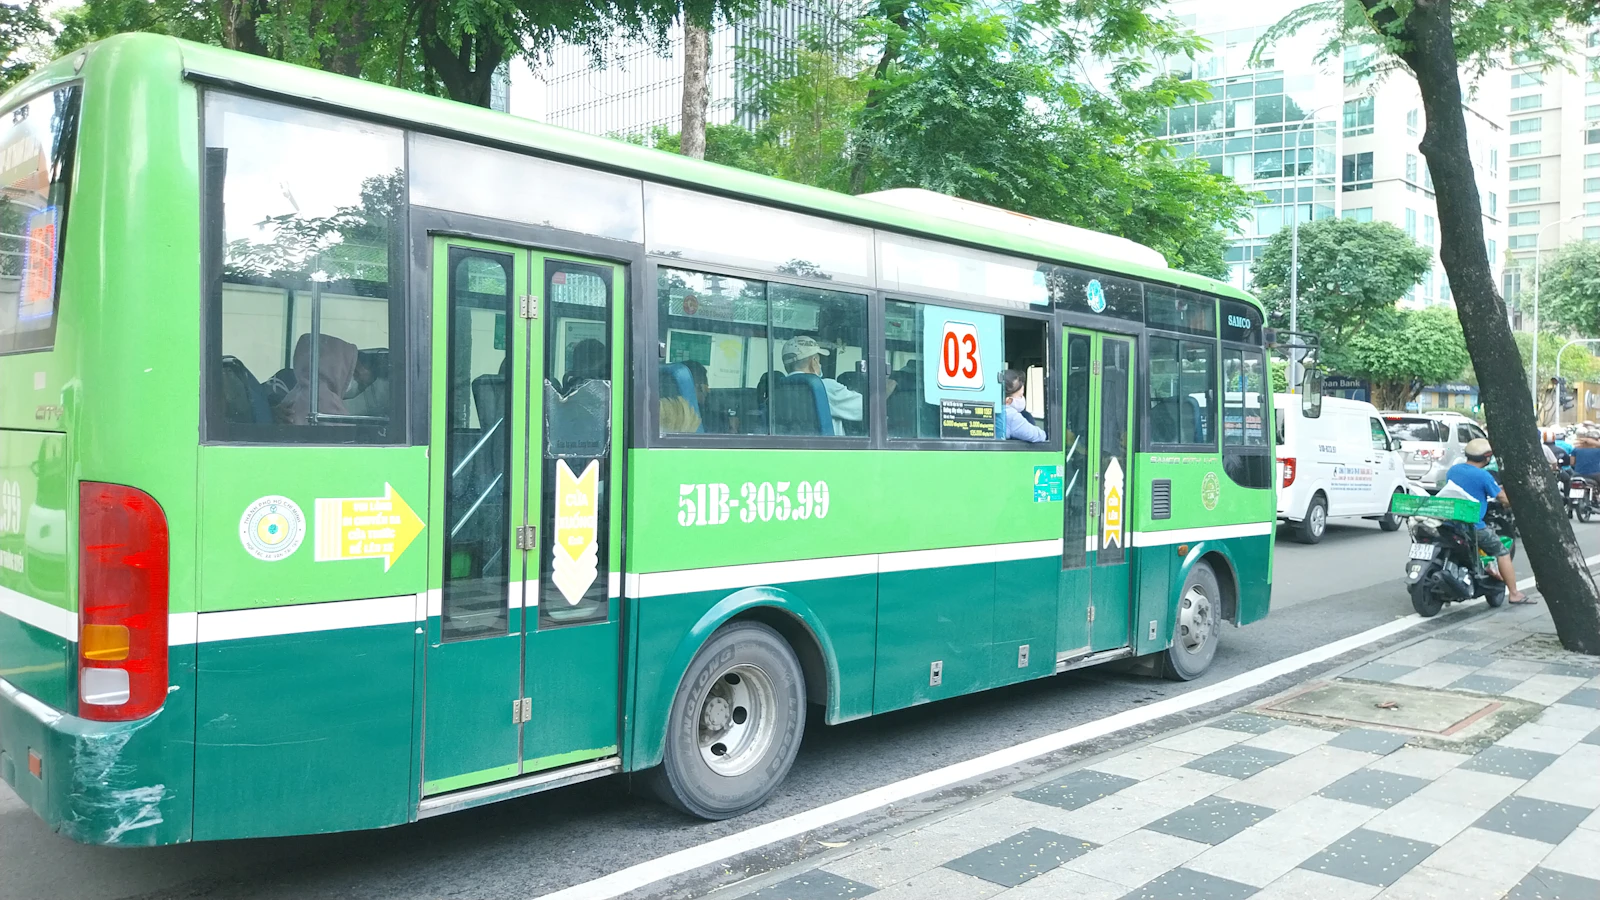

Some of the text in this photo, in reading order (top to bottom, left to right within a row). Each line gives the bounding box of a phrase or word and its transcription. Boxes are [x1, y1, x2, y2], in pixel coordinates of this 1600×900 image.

[1228, 314, 1251, 329] SAMCO
[943, 331, 978, 379] 03
[1340, 379, 1361, 387] Bank
[677, 480, 830, 527] 51B-305.99
